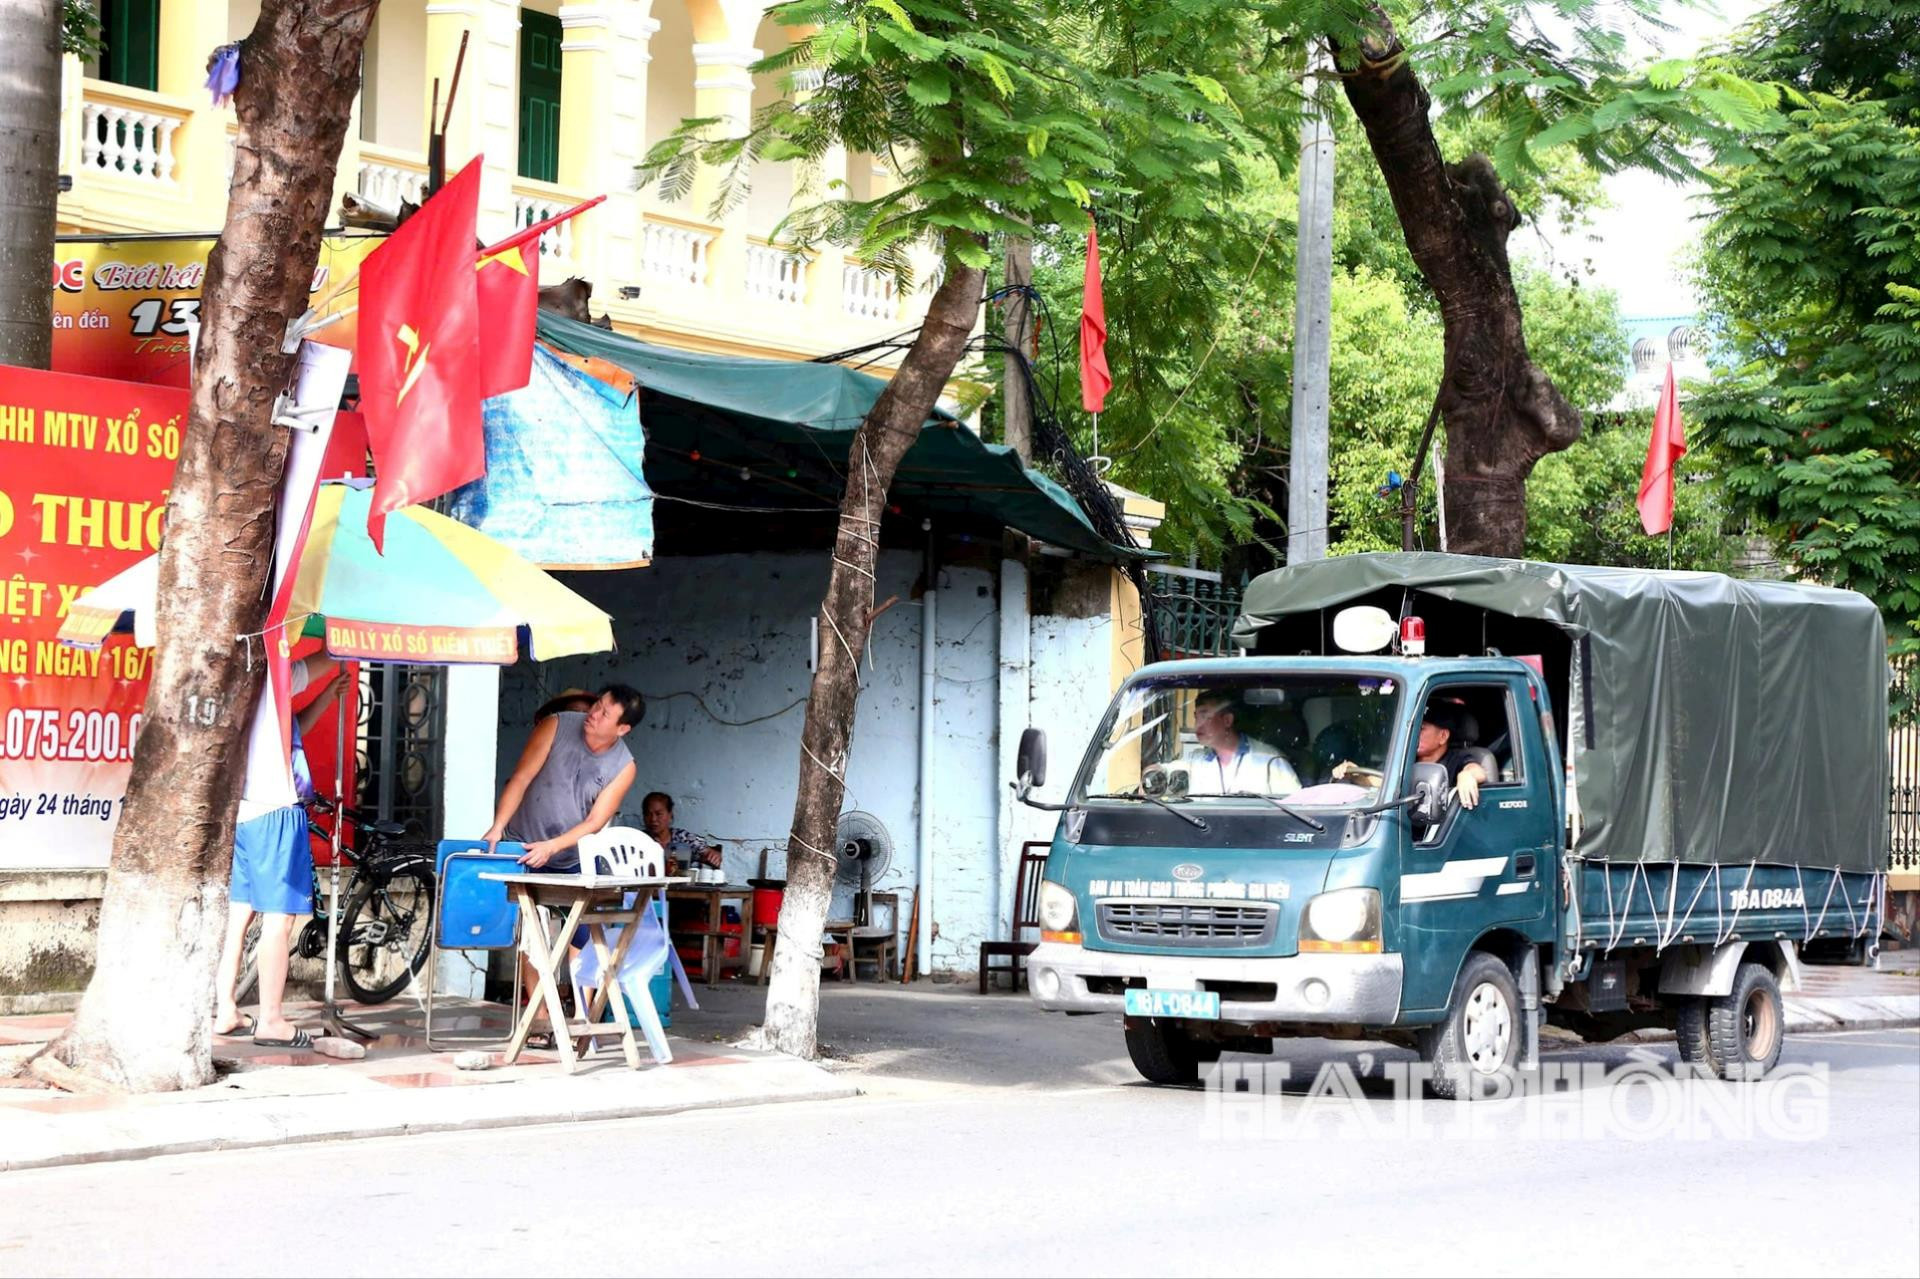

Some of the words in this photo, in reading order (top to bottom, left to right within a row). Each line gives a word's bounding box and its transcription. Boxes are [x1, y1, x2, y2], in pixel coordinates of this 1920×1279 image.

[94, 262, 159, 290] Biết
[78, 308, 110, 329] đến
[43, 410, 98, 450] MTV
[104, 408, 141, 455] XỔ
[147, 415, 182, 460] SỐ
[330, 627, 356, 652] ĐẠI
[360, 629, 378, 650] LÝ
[381, 626, 403, 652] XỔ
[407, 630, 429, 654] SỐ
[36, 793, 58, 815] 24
[62, 793, 113, 821] tháng
[1283, 832, 1315, 843] SILENT
[1729, 888, 1805, 910] 16A0844
